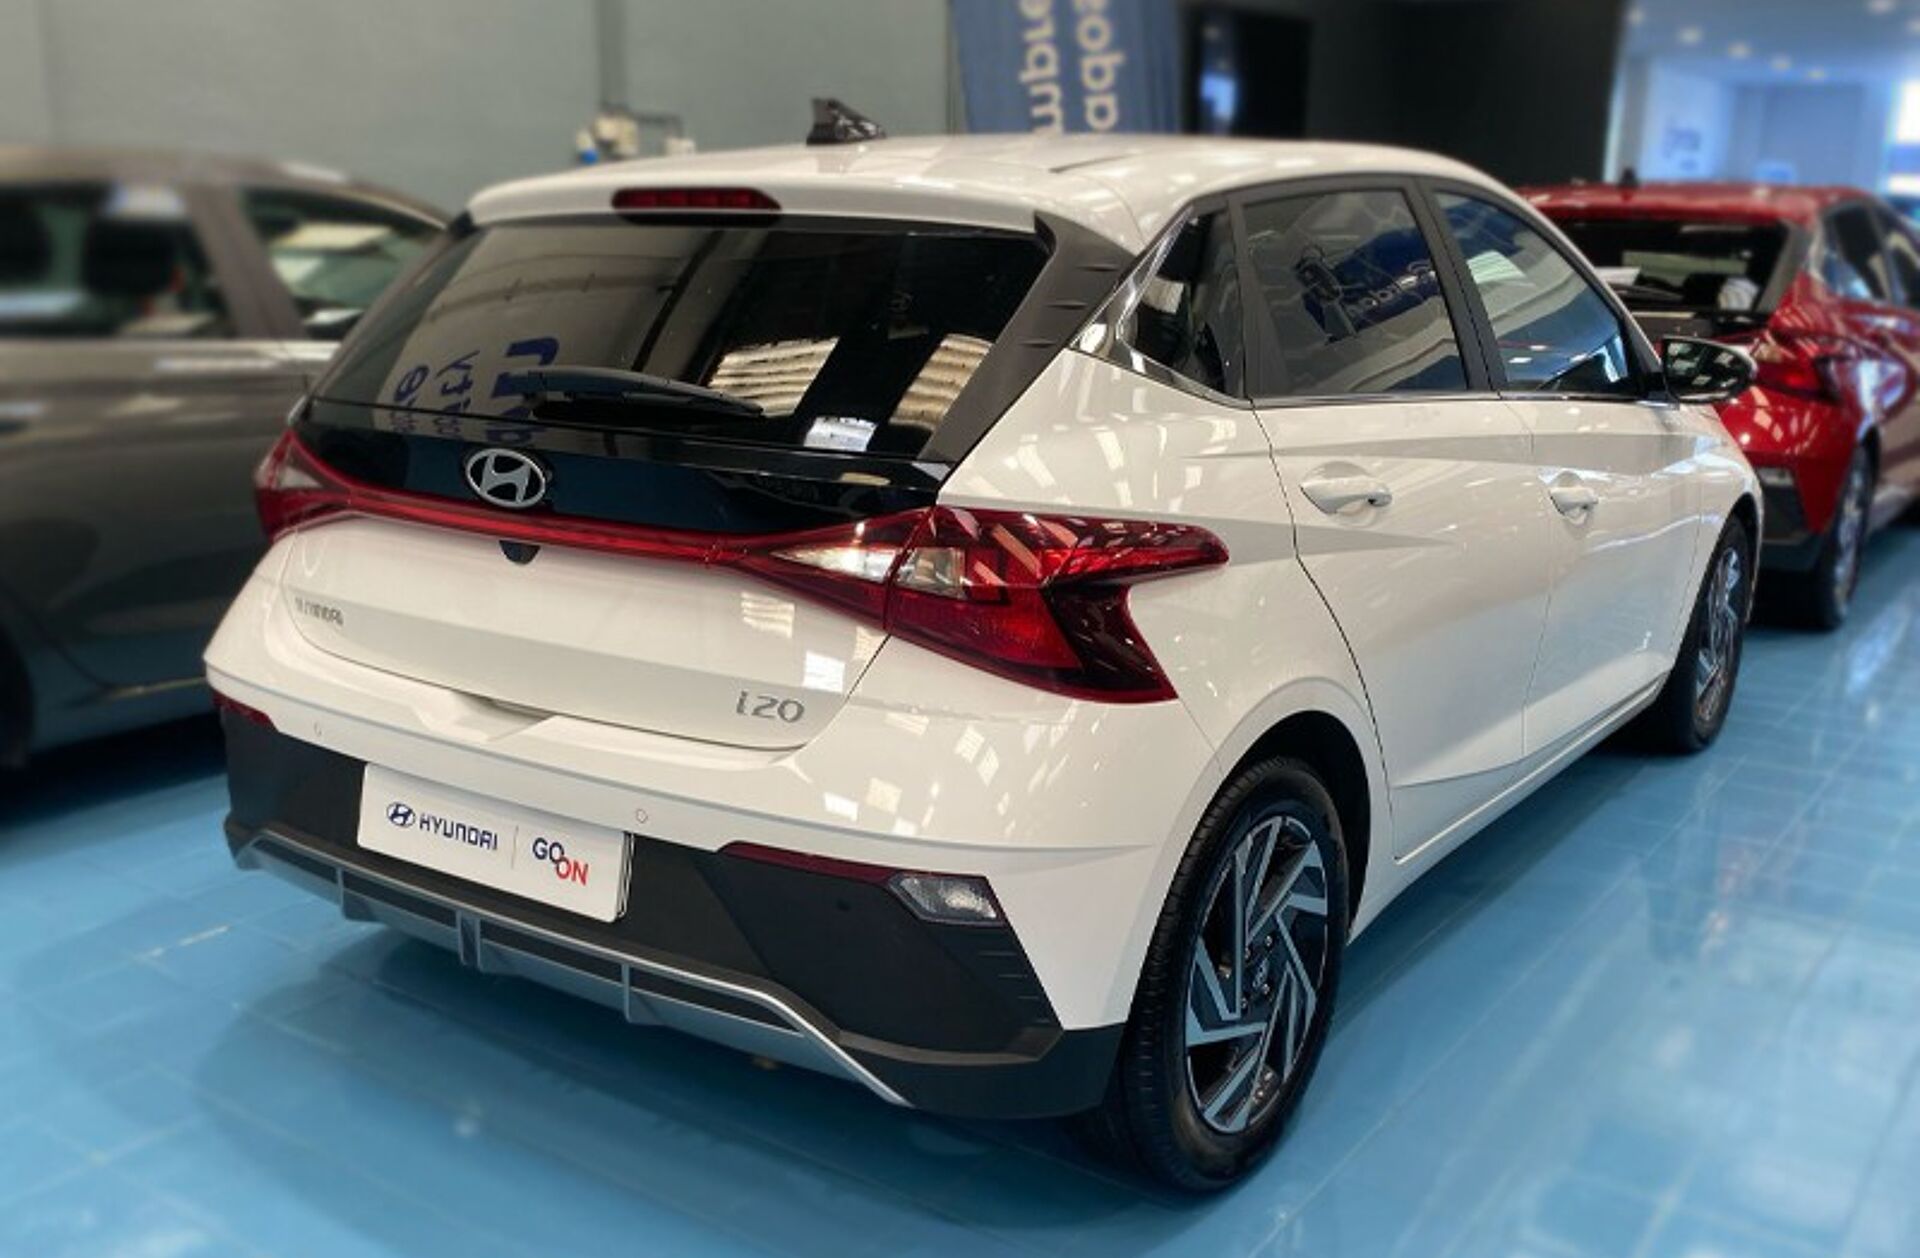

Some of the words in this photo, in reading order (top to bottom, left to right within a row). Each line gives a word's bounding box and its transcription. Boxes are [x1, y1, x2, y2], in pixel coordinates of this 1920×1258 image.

[736, 690, 804, 722] i20
[418, 813, 498, 851] HYUNDAI
[532, 838, 564, 864] GO
[555, 856, 589, 886] ON
